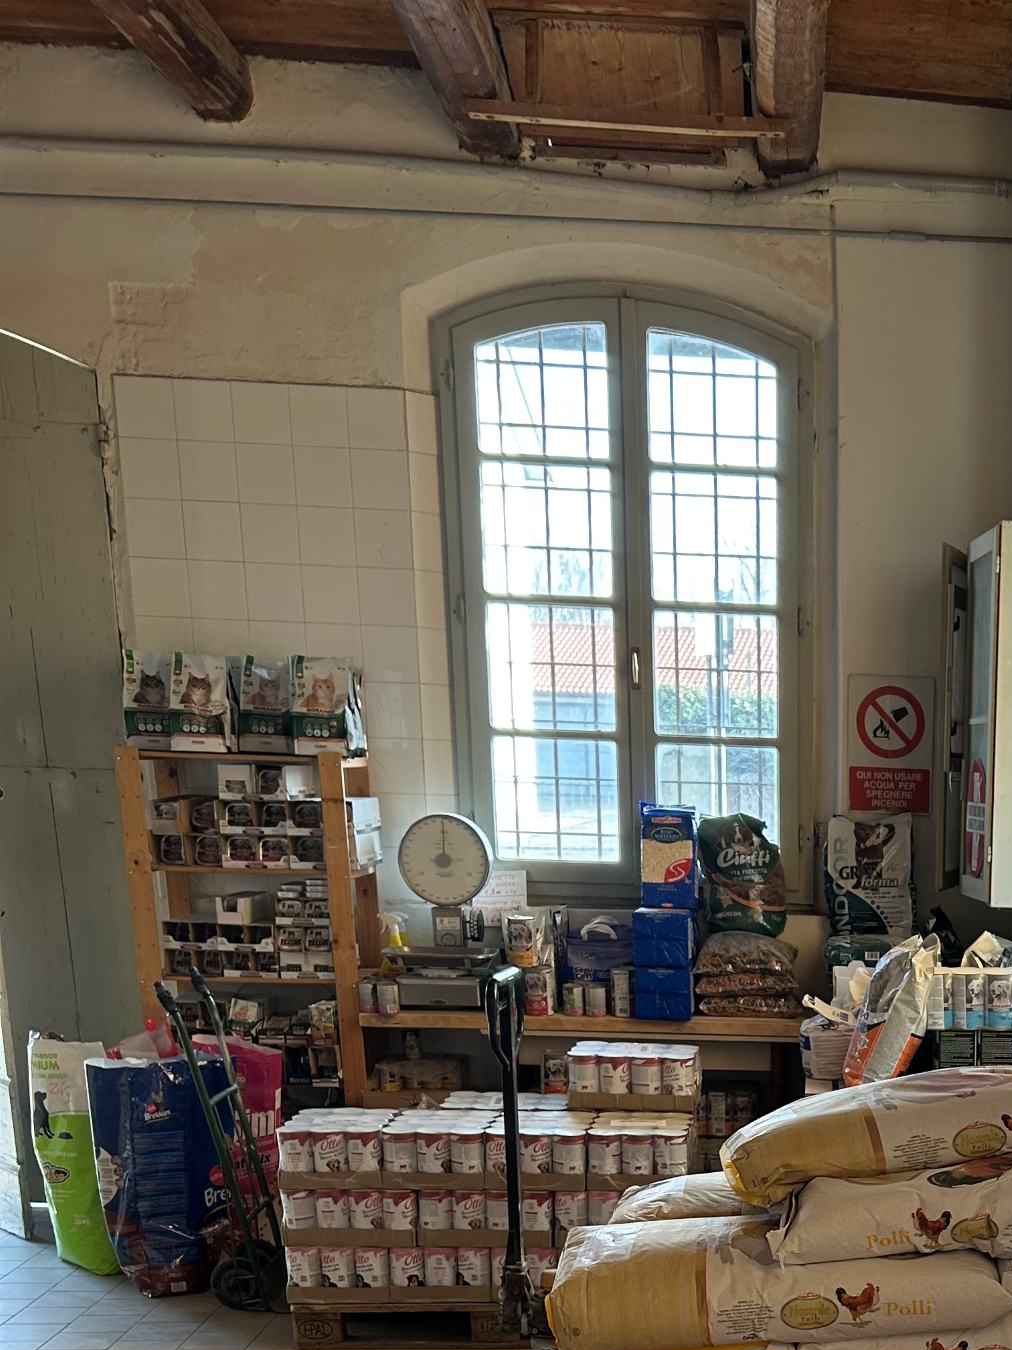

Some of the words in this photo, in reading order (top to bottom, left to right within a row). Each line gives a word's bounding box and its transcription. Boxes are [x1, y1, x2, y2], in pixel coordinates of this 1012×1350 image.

[856, 771, 872, 779] QUI
[874, 771, 892, 780] NON
[894, 772, 924, 781] USARE
[864, 781, 894, 789] ACQUA
[899, 782, 916, 790] PER
[866, 790, 913, 799] SPEGNERE
[871, 800, 907, 808] INCENDI
[716, 850, 770, 869] Ciuffi
[838, 865, 882, 880] GRAN
[860, 874, 898, 888] forma
[866, 1230, 912, 1249] Polli
[884, 1300, 933, 1318] Polli
